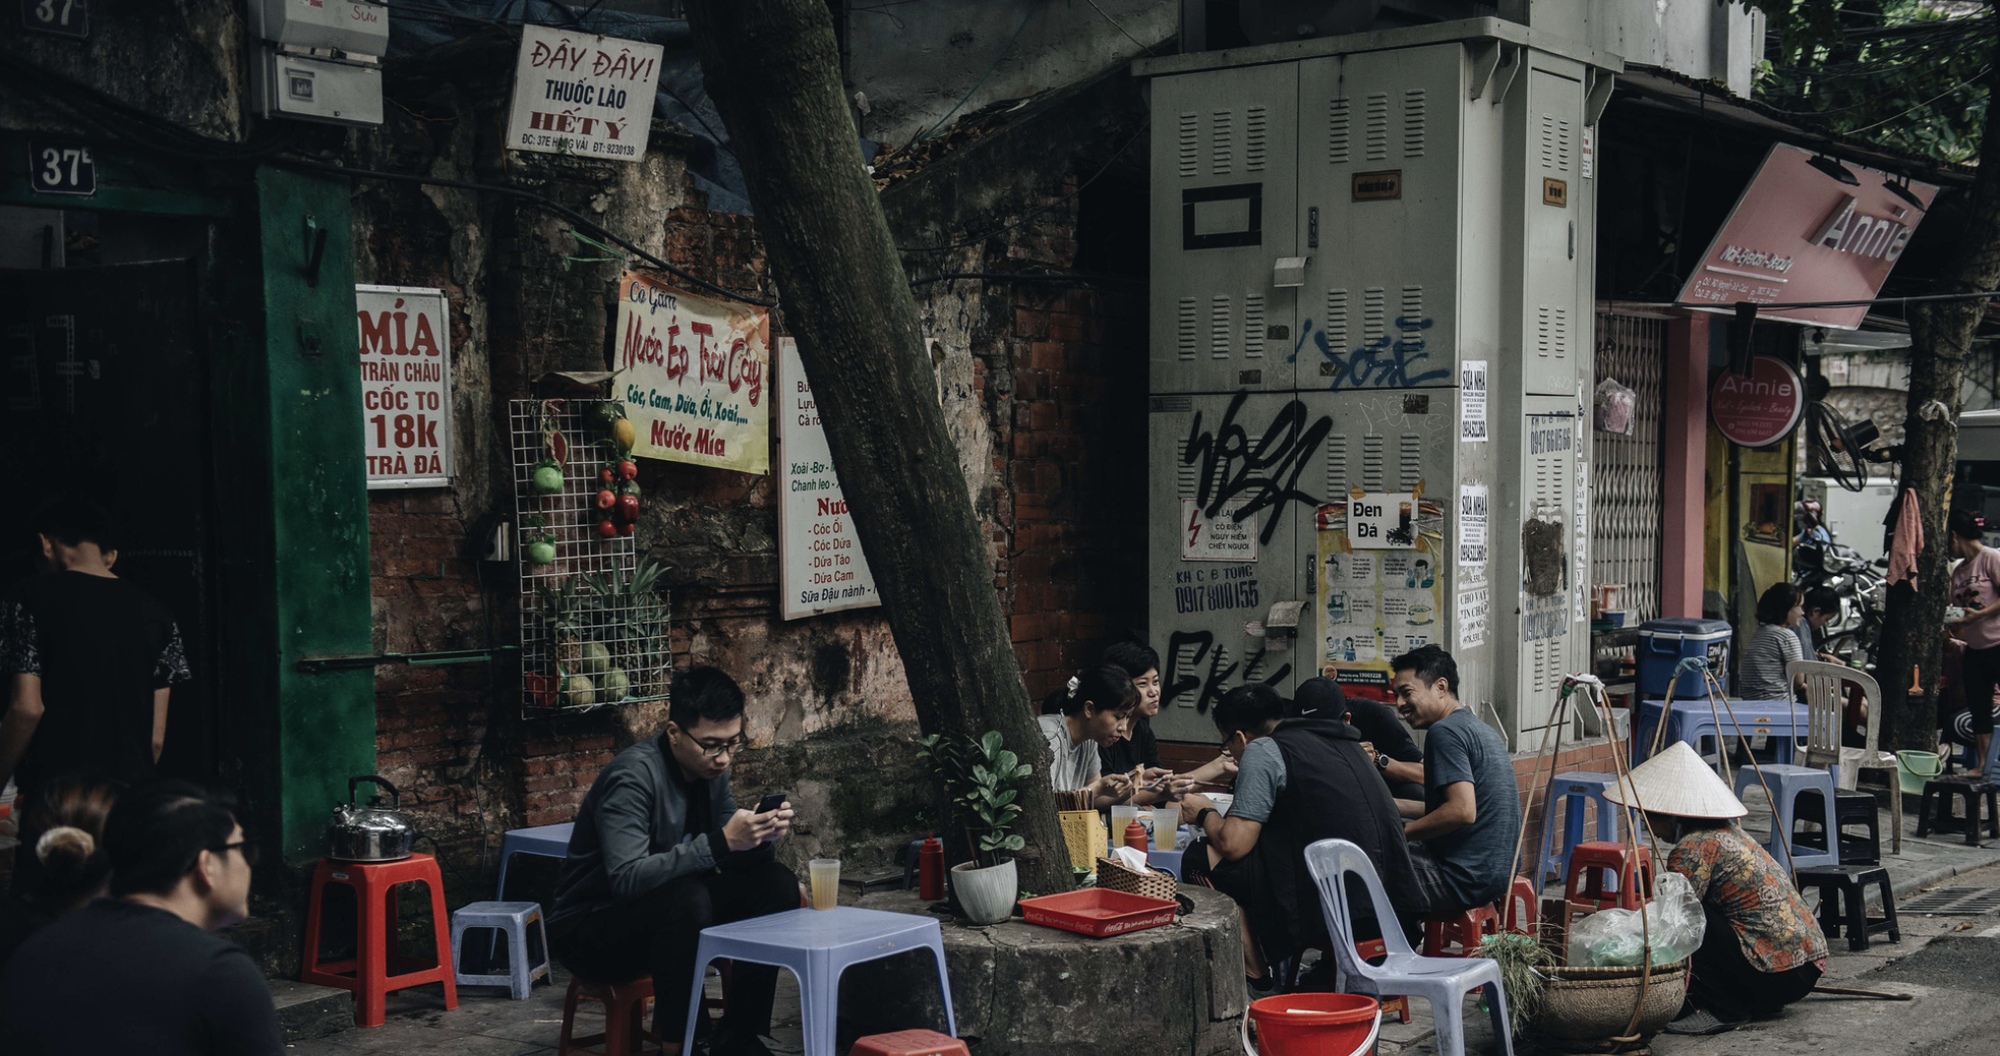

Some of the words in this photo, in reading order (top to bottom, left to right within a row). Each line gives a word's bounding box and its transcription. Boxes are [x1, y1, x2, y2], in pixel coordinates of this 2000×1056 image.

[531, 38, 587, 72] ĐÂY
[592, 48, 655, 83] ĐÂY!
[545, 77, 594, 105] THUỐC
[597, 84, 627, 110] LÀO
[528, 107, 599, 135] HẾT
[603, 117, 628, 140] Ý
[522, 133, 536, 145] ĐC:
[537, 135, 551, 147] 37E
[593, 142, 606, 153] ĐT:
[1813, 195, 1911, 262] Annie
[357, 298, 440, 356] MÍA
[622, 309, 664, 373] Nước
[666, 315, 690, 388] Ép
[691, 321, 727, 386] Trái
[728, 337, 762, 408] Cây
[360, 357, 399, 382] TRÂN
[404, 358, 440, 382] CHÂU
[1720, 376, 1791, 397] Annie
[365, 383, 408, 411] CỐC
[415, 391, 439, 411] TO
[649, 388, 672, 414] Cam,
[674, 393, 697, 419] Dứa,
[798, 413, 810, 426] Cà
[651, 419, 692, 452] Nước
[694, 427, 725, 457] Mía
[366, 451, 407, 475] TRÀ
[414, 450, 442, 474] ĐÁ
[791, 478, 816, 492] Chanh
[817, 477, 830, 491] leo
[1353, 502, 1382, 517] Đen
[813, 523, 831, 536] Cóc
[832, 517, 843, 534] Ổi
[1358, 522, 1378, 538] Đá
[813, 539, 831, 552] Cóc
[833, 537, 851, 550] Dứa
[1210, 533, 1229, 541] NGUY
[814, 556, 832, 568] Dứa
[834, 554, 850, 567] Táo
[814, 572, 833, 584] Dứa
[834, 570, 854, 582] Cam
[842, 585, 865, 598] nành
[1460, 592, 1474, 606] CHO
